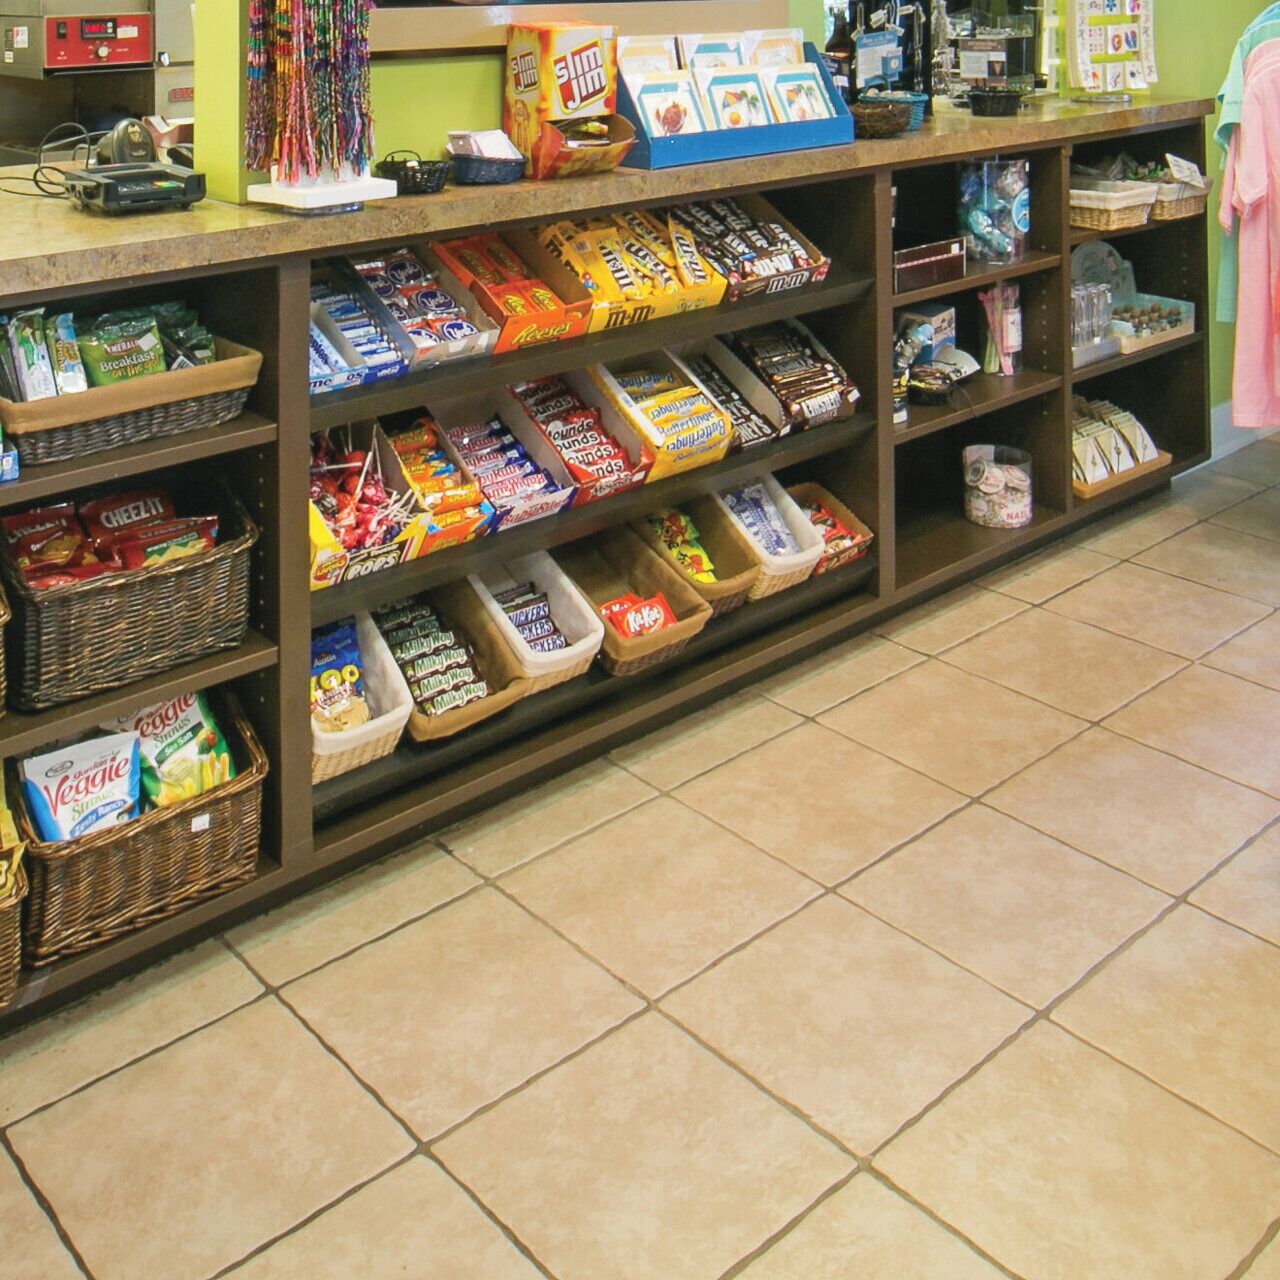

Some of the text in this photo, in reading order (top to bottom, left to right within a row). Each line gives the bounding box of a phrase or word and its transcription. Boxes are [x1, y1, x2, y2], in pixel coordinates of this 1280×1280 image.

[511, 320, 574, 346] Reese's
[99, 351, 156, 372] Breakfast
[344, 550, 401, 582] POPS
[508, 602, 549, 627] NICKERS
[164, 731, 194, 756] Sea Salt
[43, 756, 131, 819] Veggie
